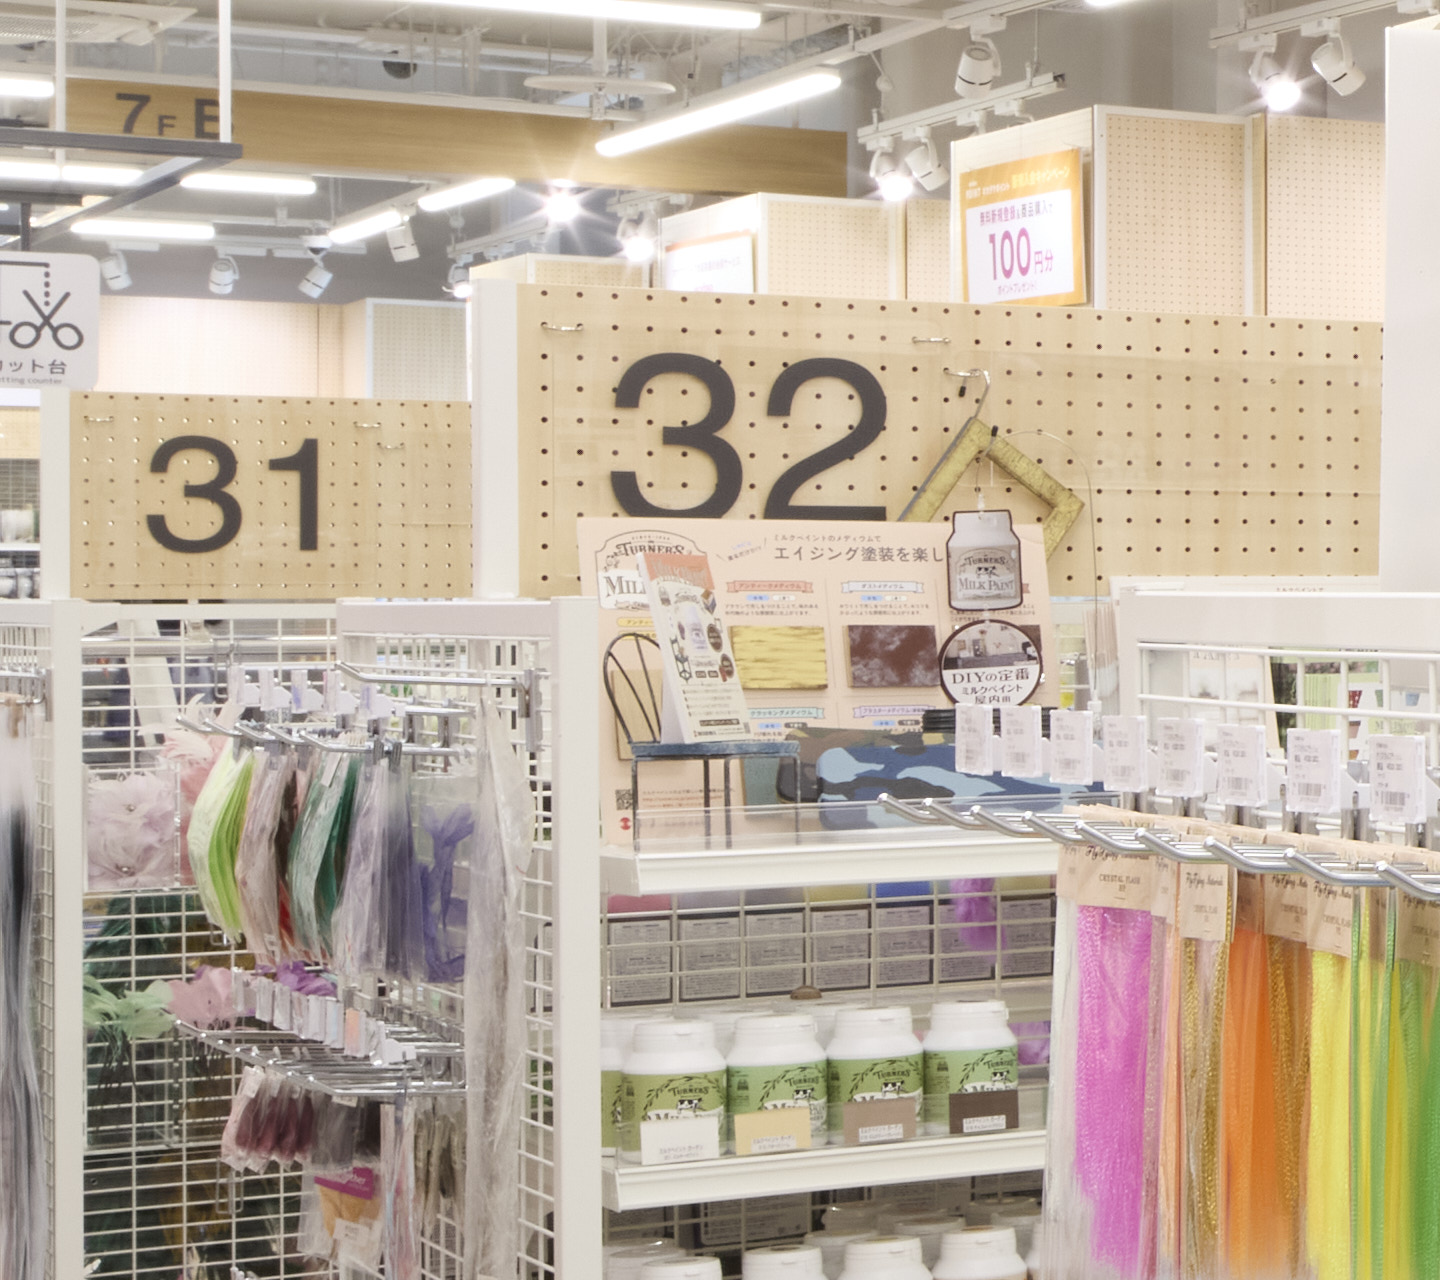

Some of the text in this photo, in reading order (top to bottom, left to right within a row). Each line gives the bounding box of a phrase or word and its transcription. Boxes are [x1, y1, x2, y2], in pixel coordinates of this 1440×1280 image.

[115, 92, 152, 135] 7
[157, 114, 177, 136] F
[610, 352, 888, 522] 32
[146, 435, 318, 553] 31
[951, 668, 1030, 685] DIYの定番
[961, 684, 1023, 695] ミルクペイント
